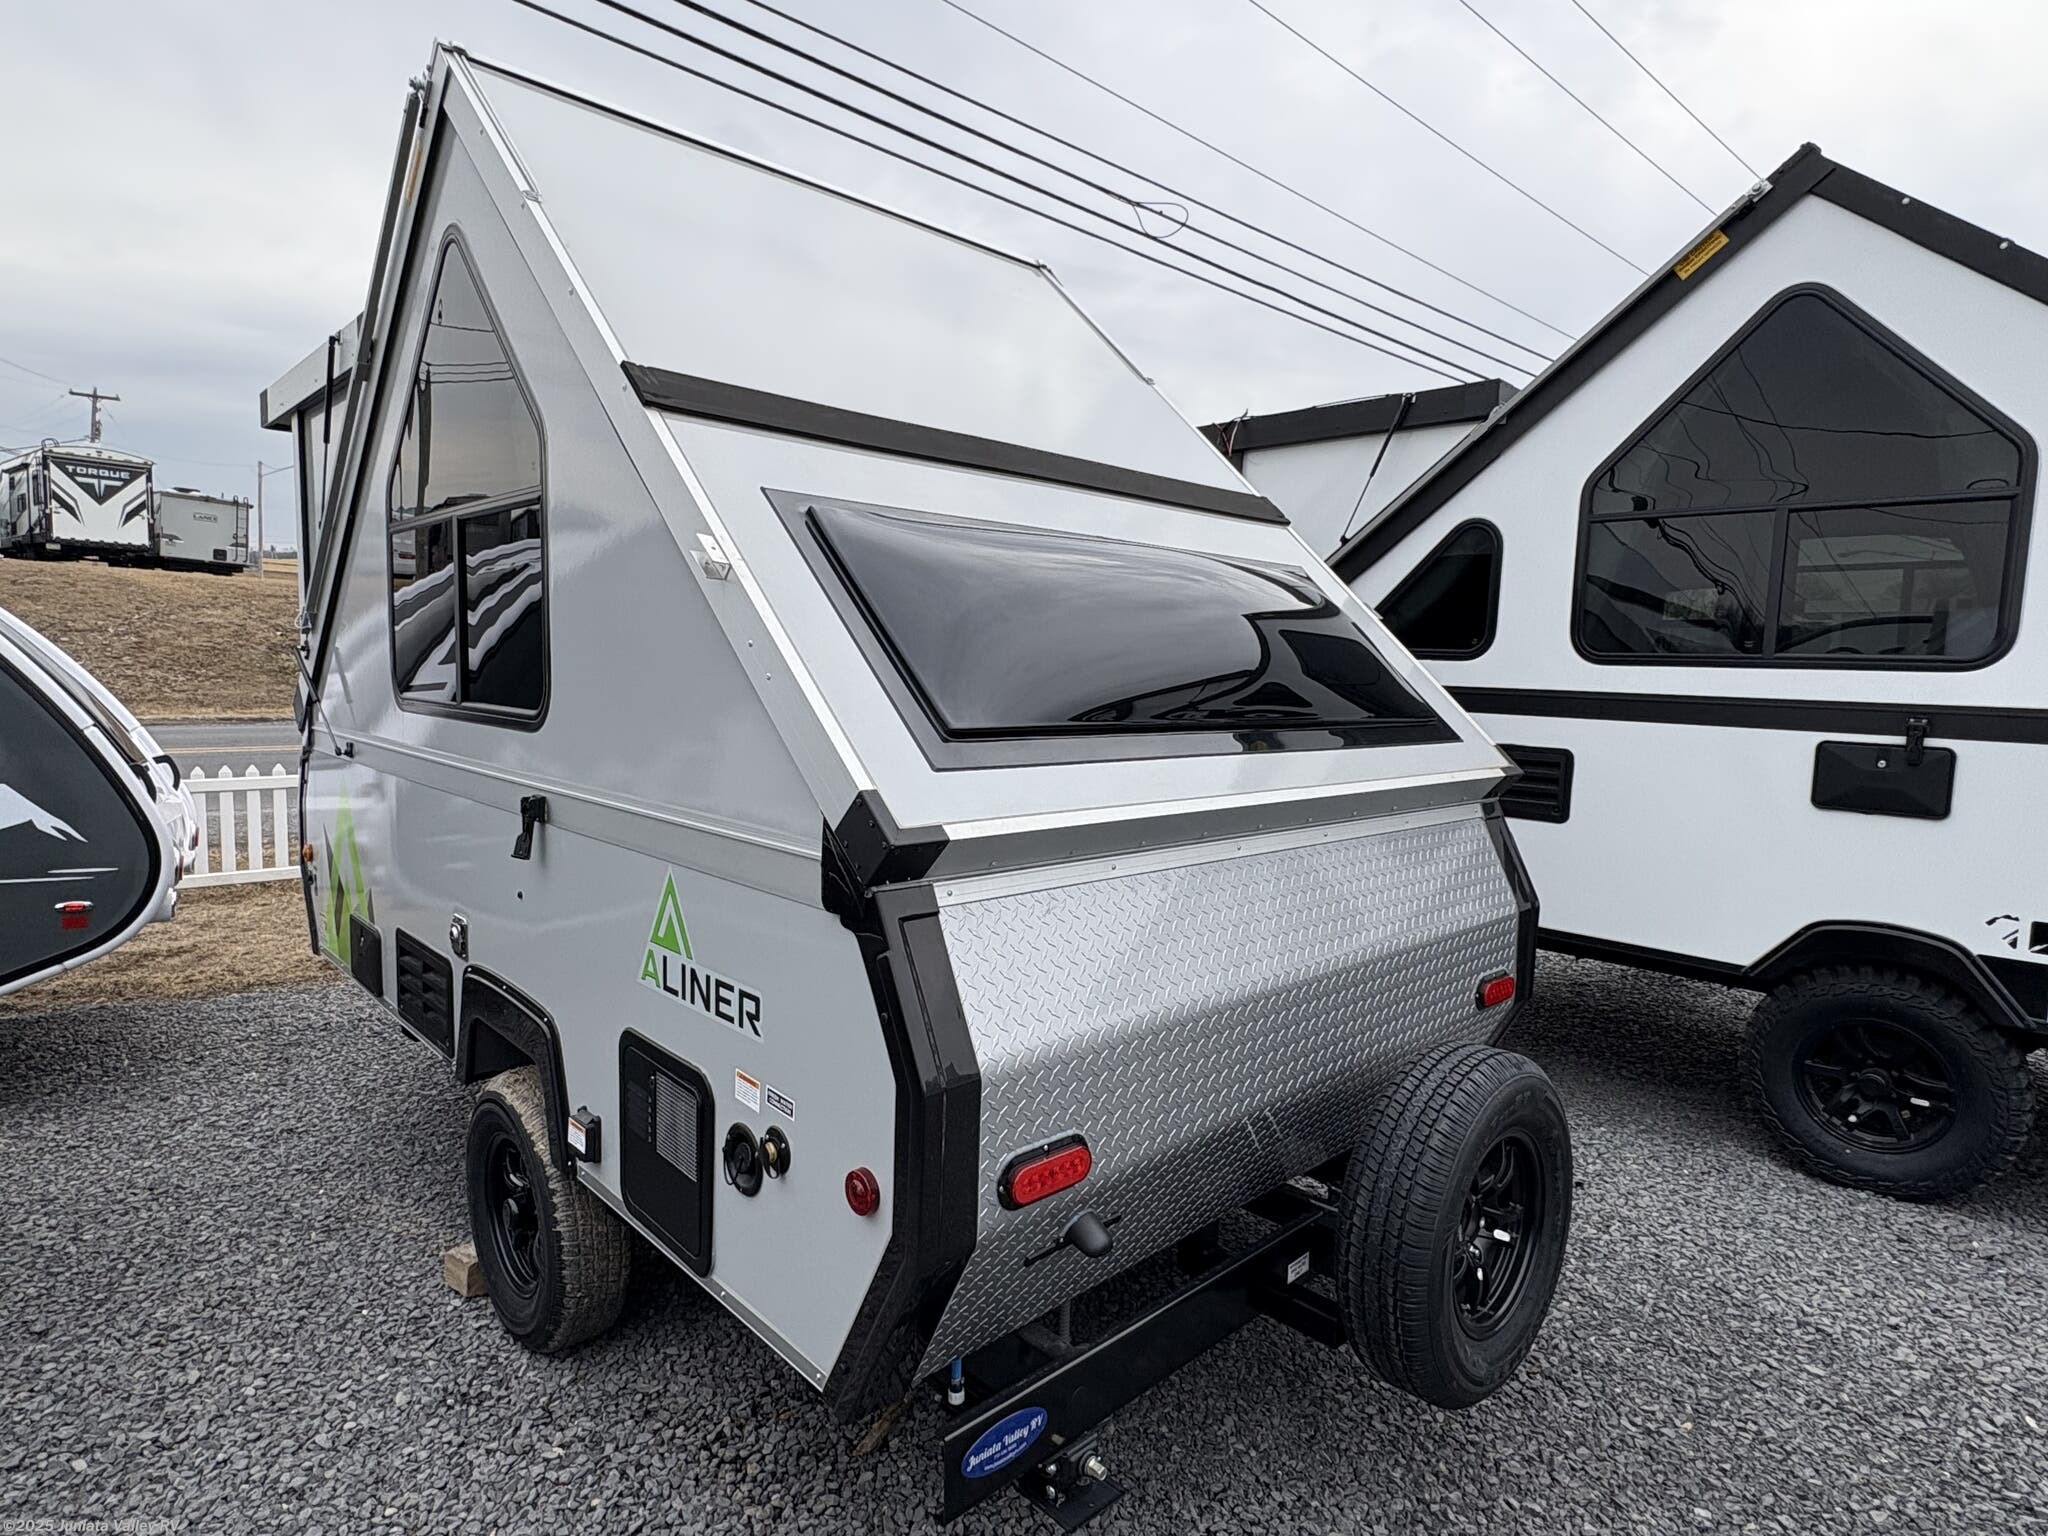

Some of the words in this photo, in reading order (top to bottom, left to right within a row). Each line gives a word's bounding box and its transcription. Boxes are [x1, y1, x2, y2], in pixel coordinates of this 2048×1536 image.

[65, 464, 131, 480] TORQUE
[641, 948, 762, 1038] ALINER
[1002, 1425, 1029, 1446] Valley
